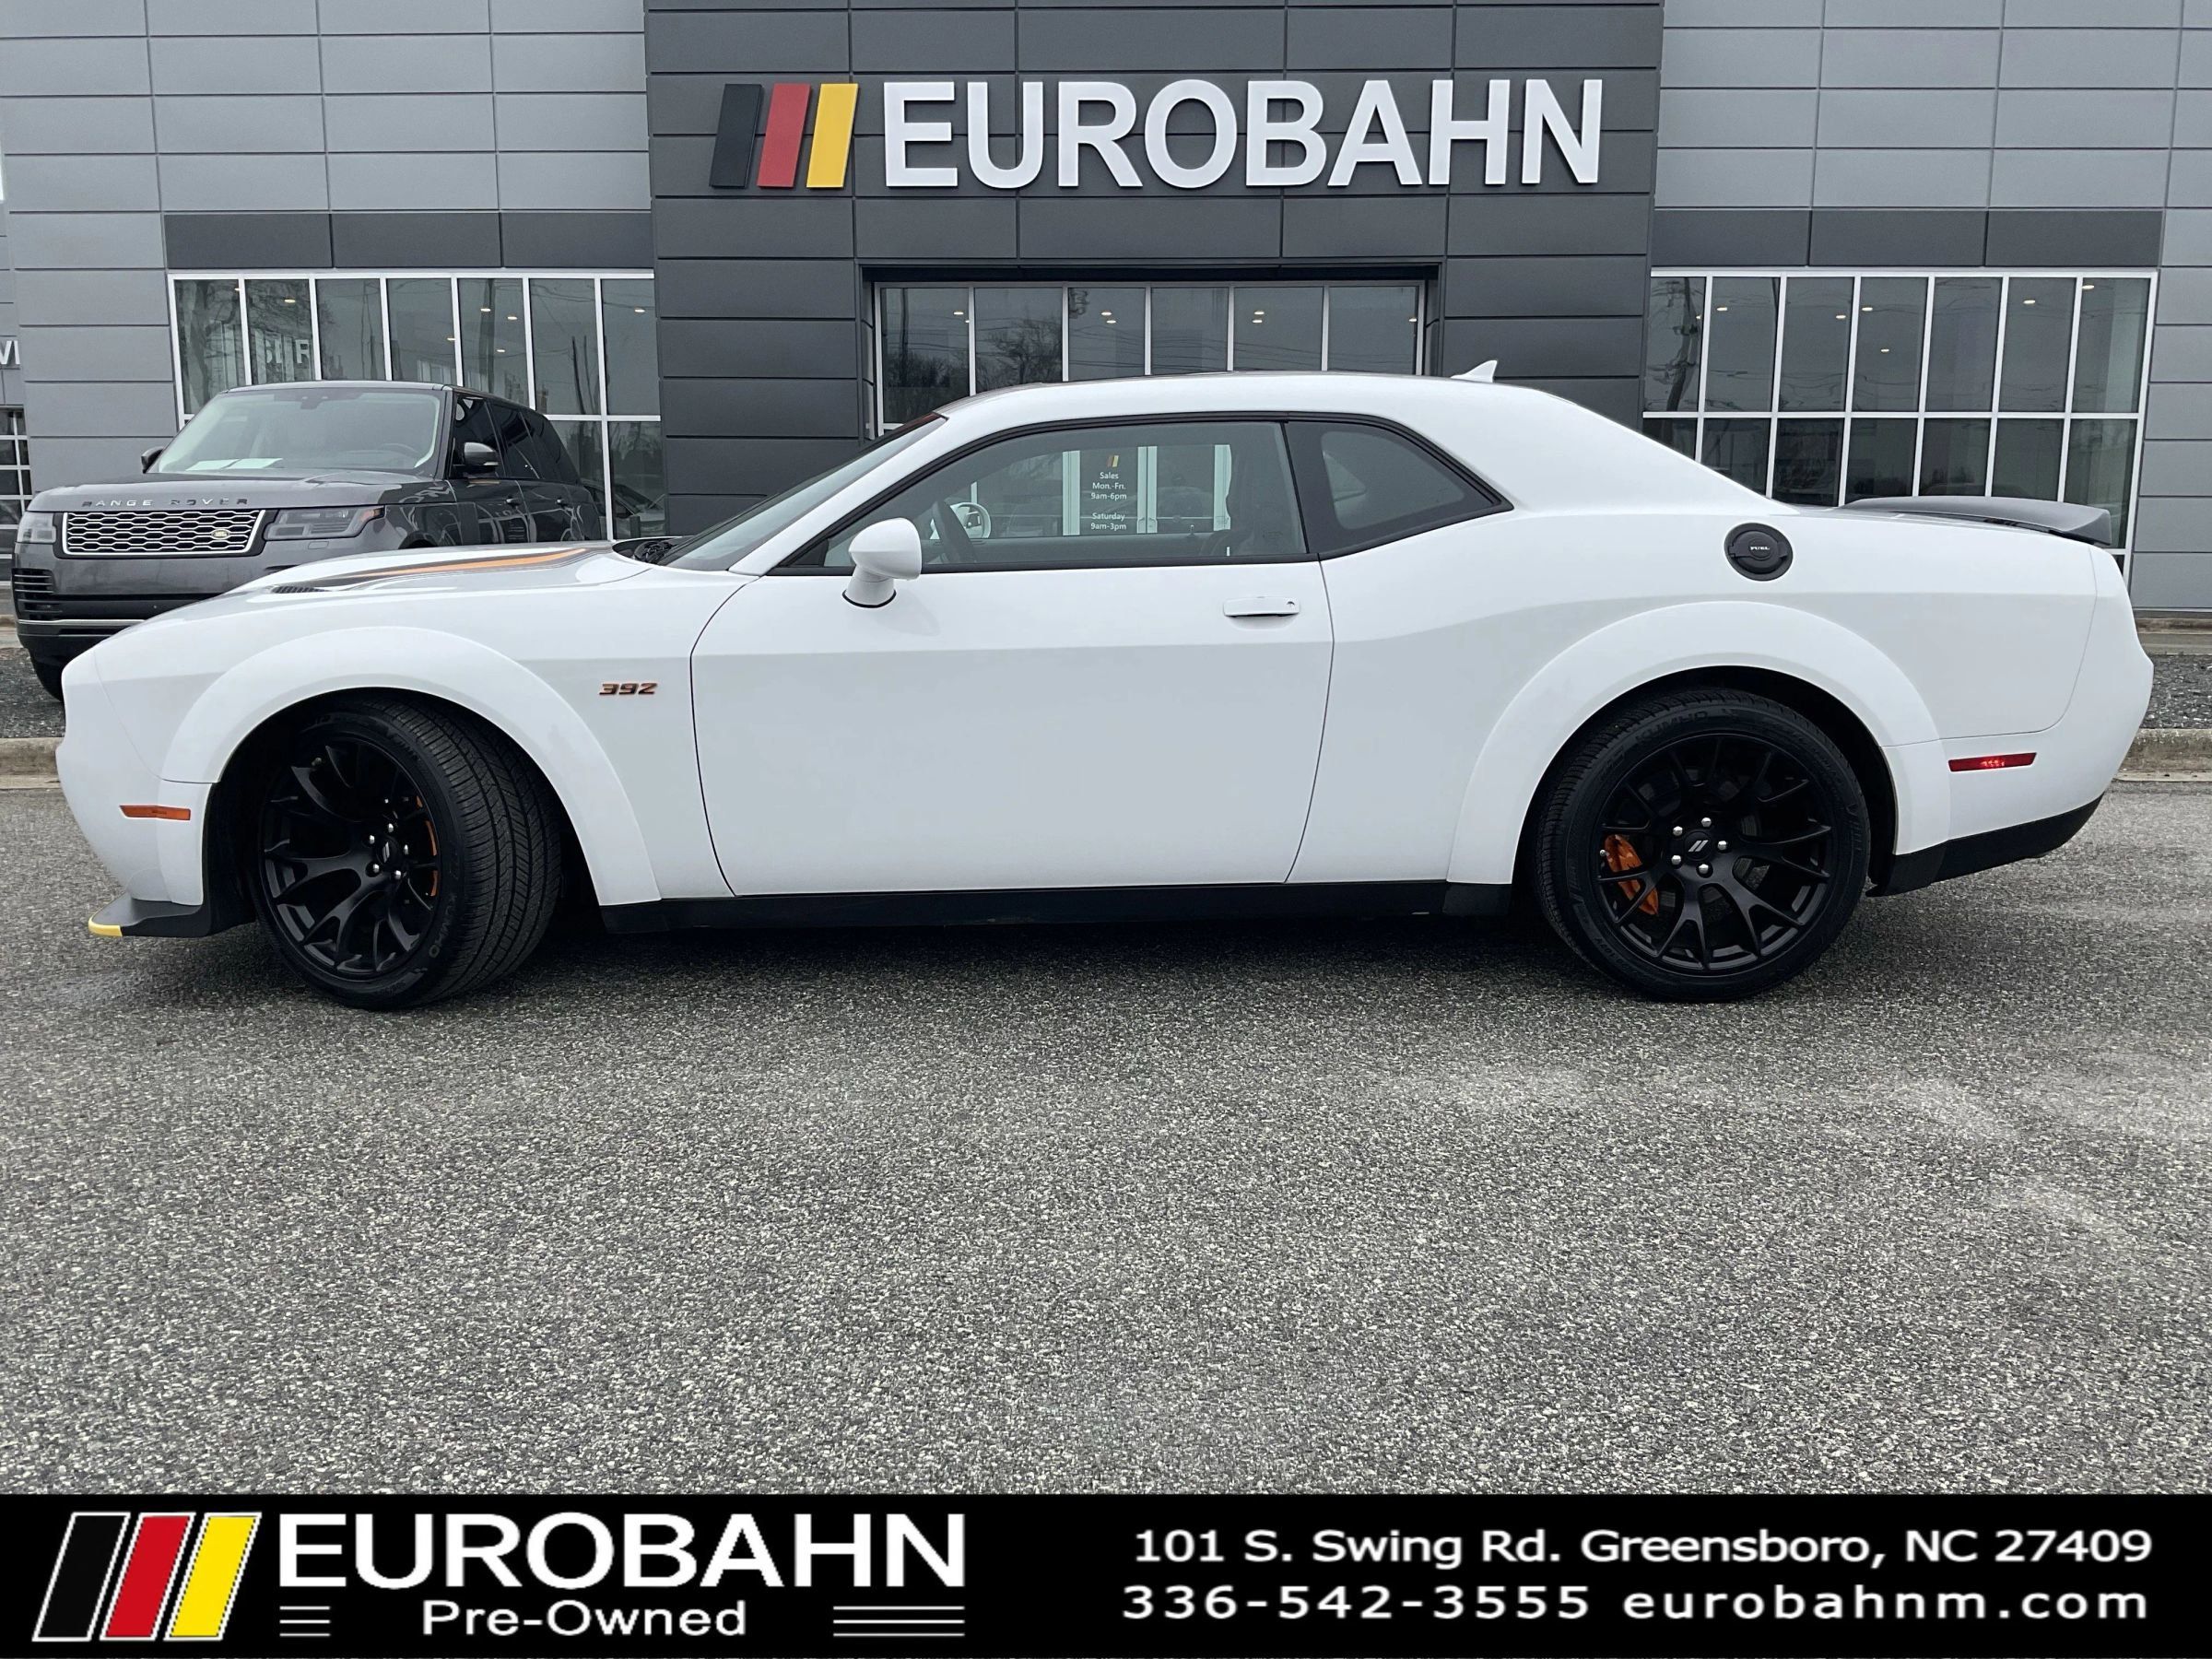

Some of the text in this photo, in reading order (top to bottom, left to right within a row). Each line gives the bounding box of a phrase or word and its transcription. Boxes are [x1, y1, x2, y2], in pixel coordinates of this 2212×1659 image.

[884, 78, 1603, 189] EUROBAHN
[1090, 492, 1127, 500] 9am-6pm
[1092, 512, 1125, 522] Saturday
[1090, 523, 1127, 531] 9am-3pm
[599, 682, 658, 696] 392
